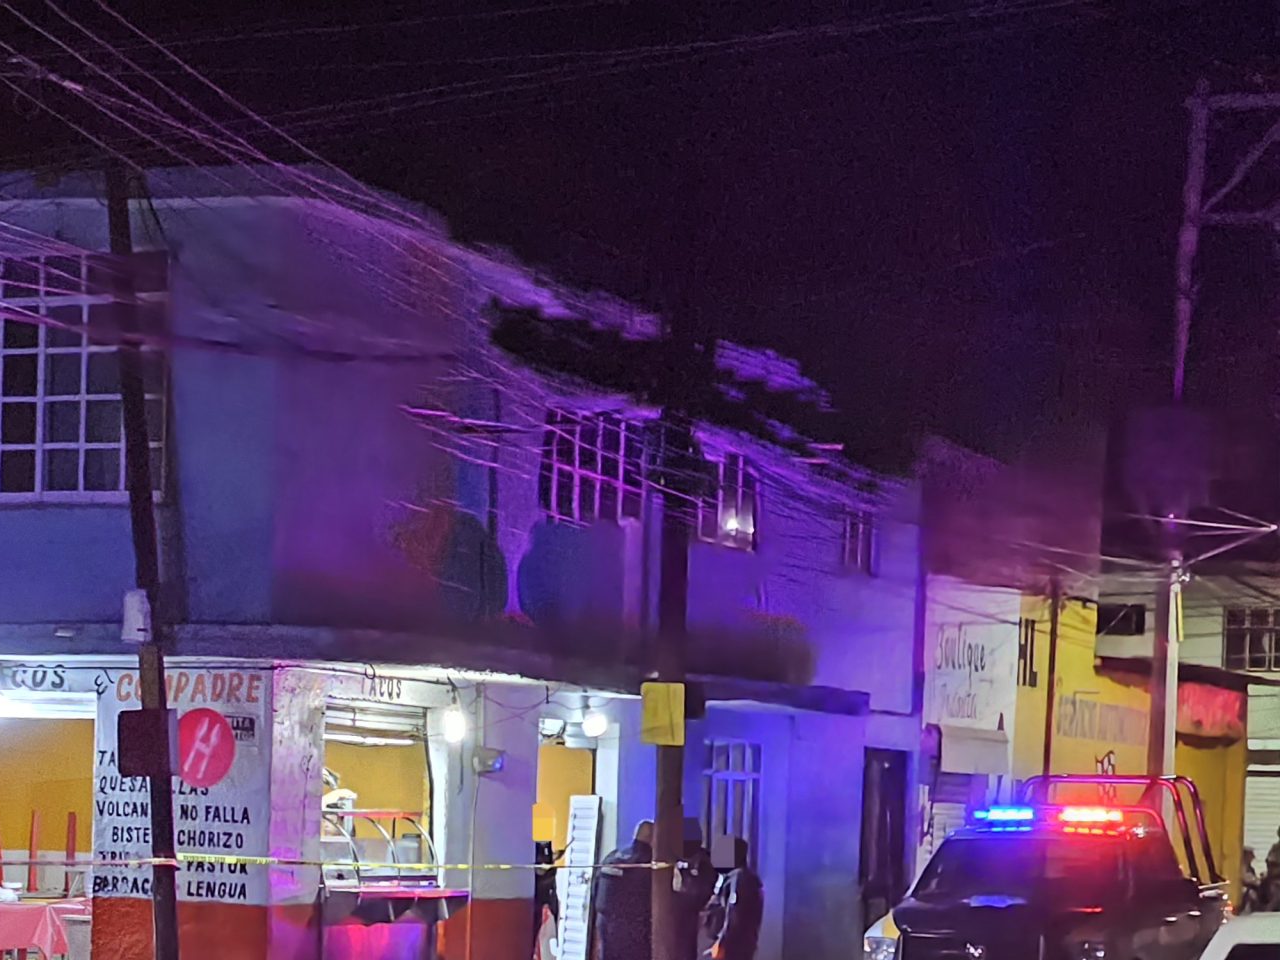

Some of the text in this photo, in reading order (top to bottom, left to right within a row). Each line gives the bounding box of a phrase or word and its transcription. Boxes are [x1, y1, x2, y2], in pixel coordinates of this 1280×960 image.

[116, 671, 263, 703] CPADRE
[361, 676, 402, 700] TACOS
[179, 804, 199, 822] NO
[205, 805, 251, 825] FALLA
[111, 826, 244, 849] BISTE CHORIZO
[186, 881, 248, 900] LENGUA
